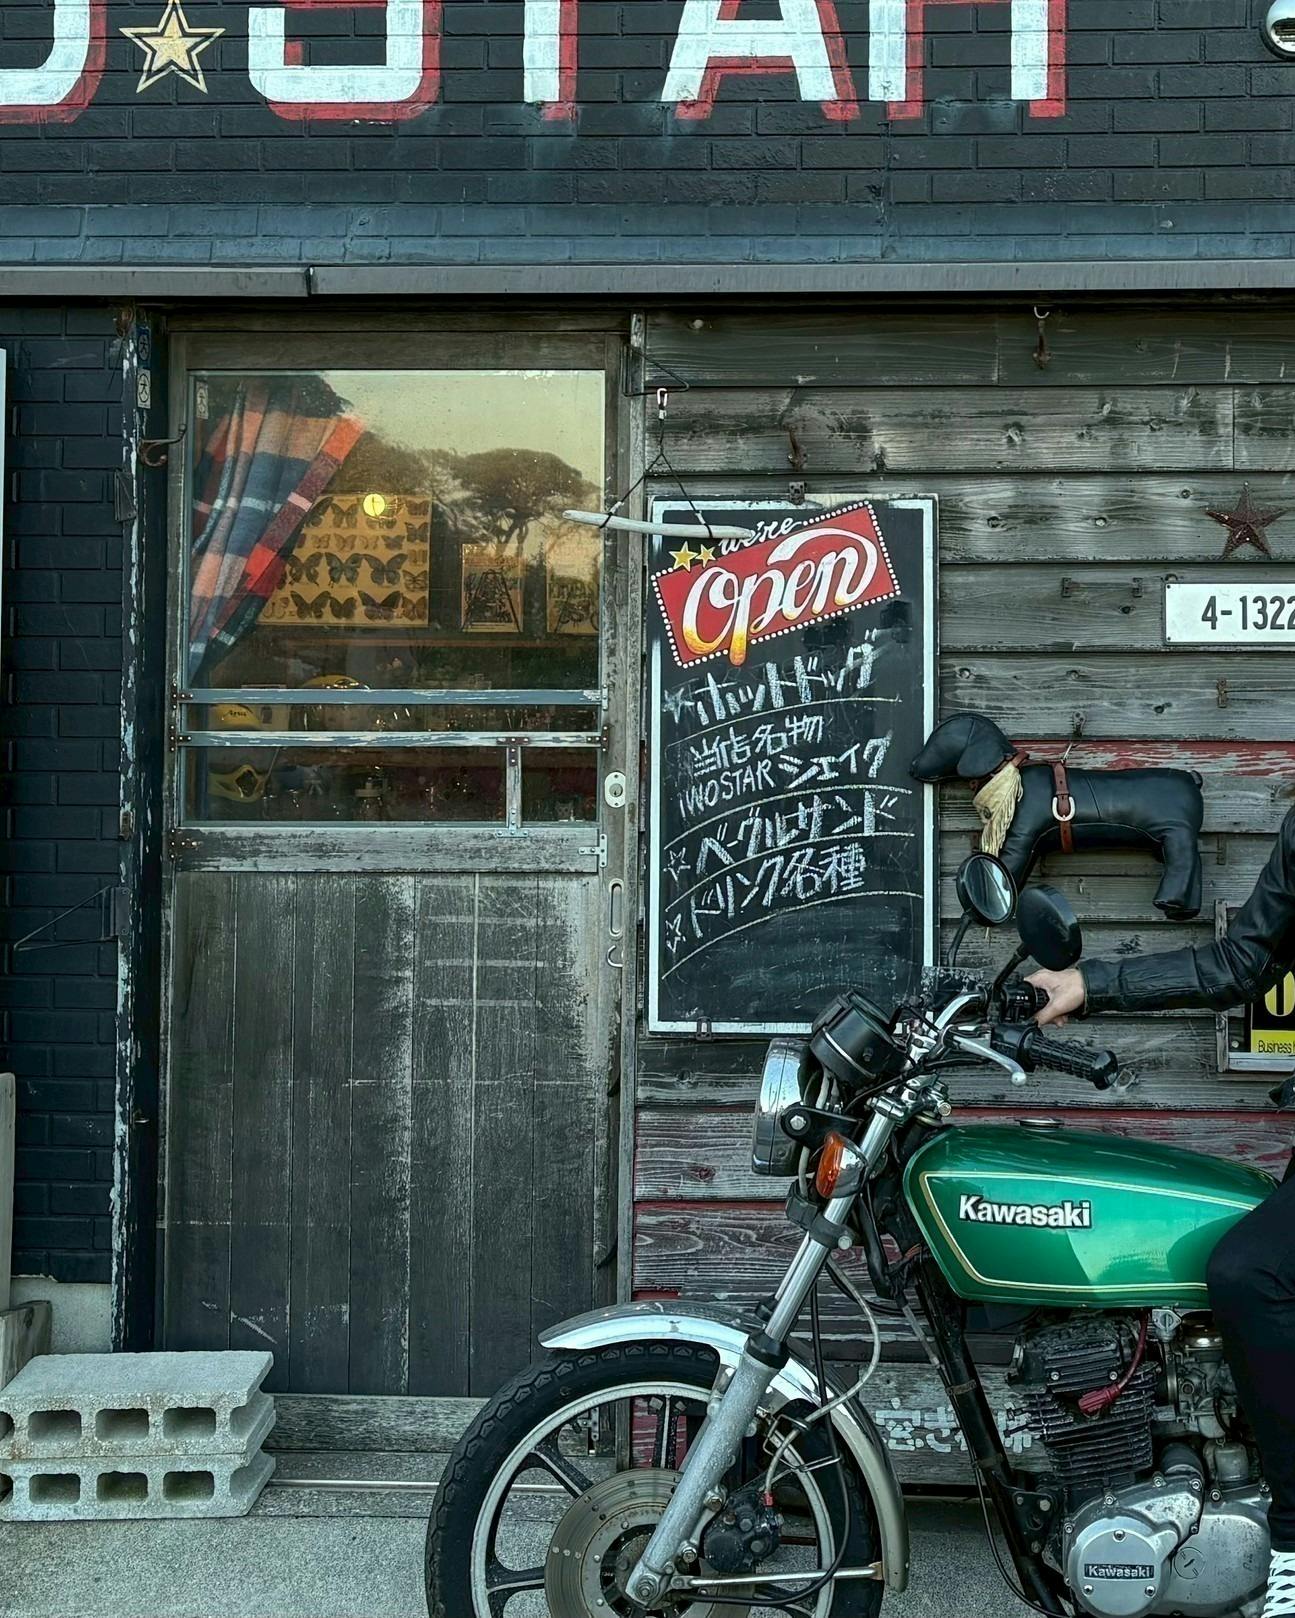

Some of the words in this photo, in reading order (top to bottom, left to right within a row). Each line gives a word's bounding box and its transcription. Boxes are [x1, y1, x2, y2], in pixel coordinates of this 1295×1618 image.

[682, 527, 878, 666] Open
[690, 714, 824, 776] 当店名物
[696, 791, 898, 875] ベーグルサンド
[690, 842, 867, 938] ドリンク各種
[1258, 1040, 1292, 1054] Business
[959, 1194, 1092, 1228] Kawasaki
[1088, 1565, 1150, 1577] Kawasaki
